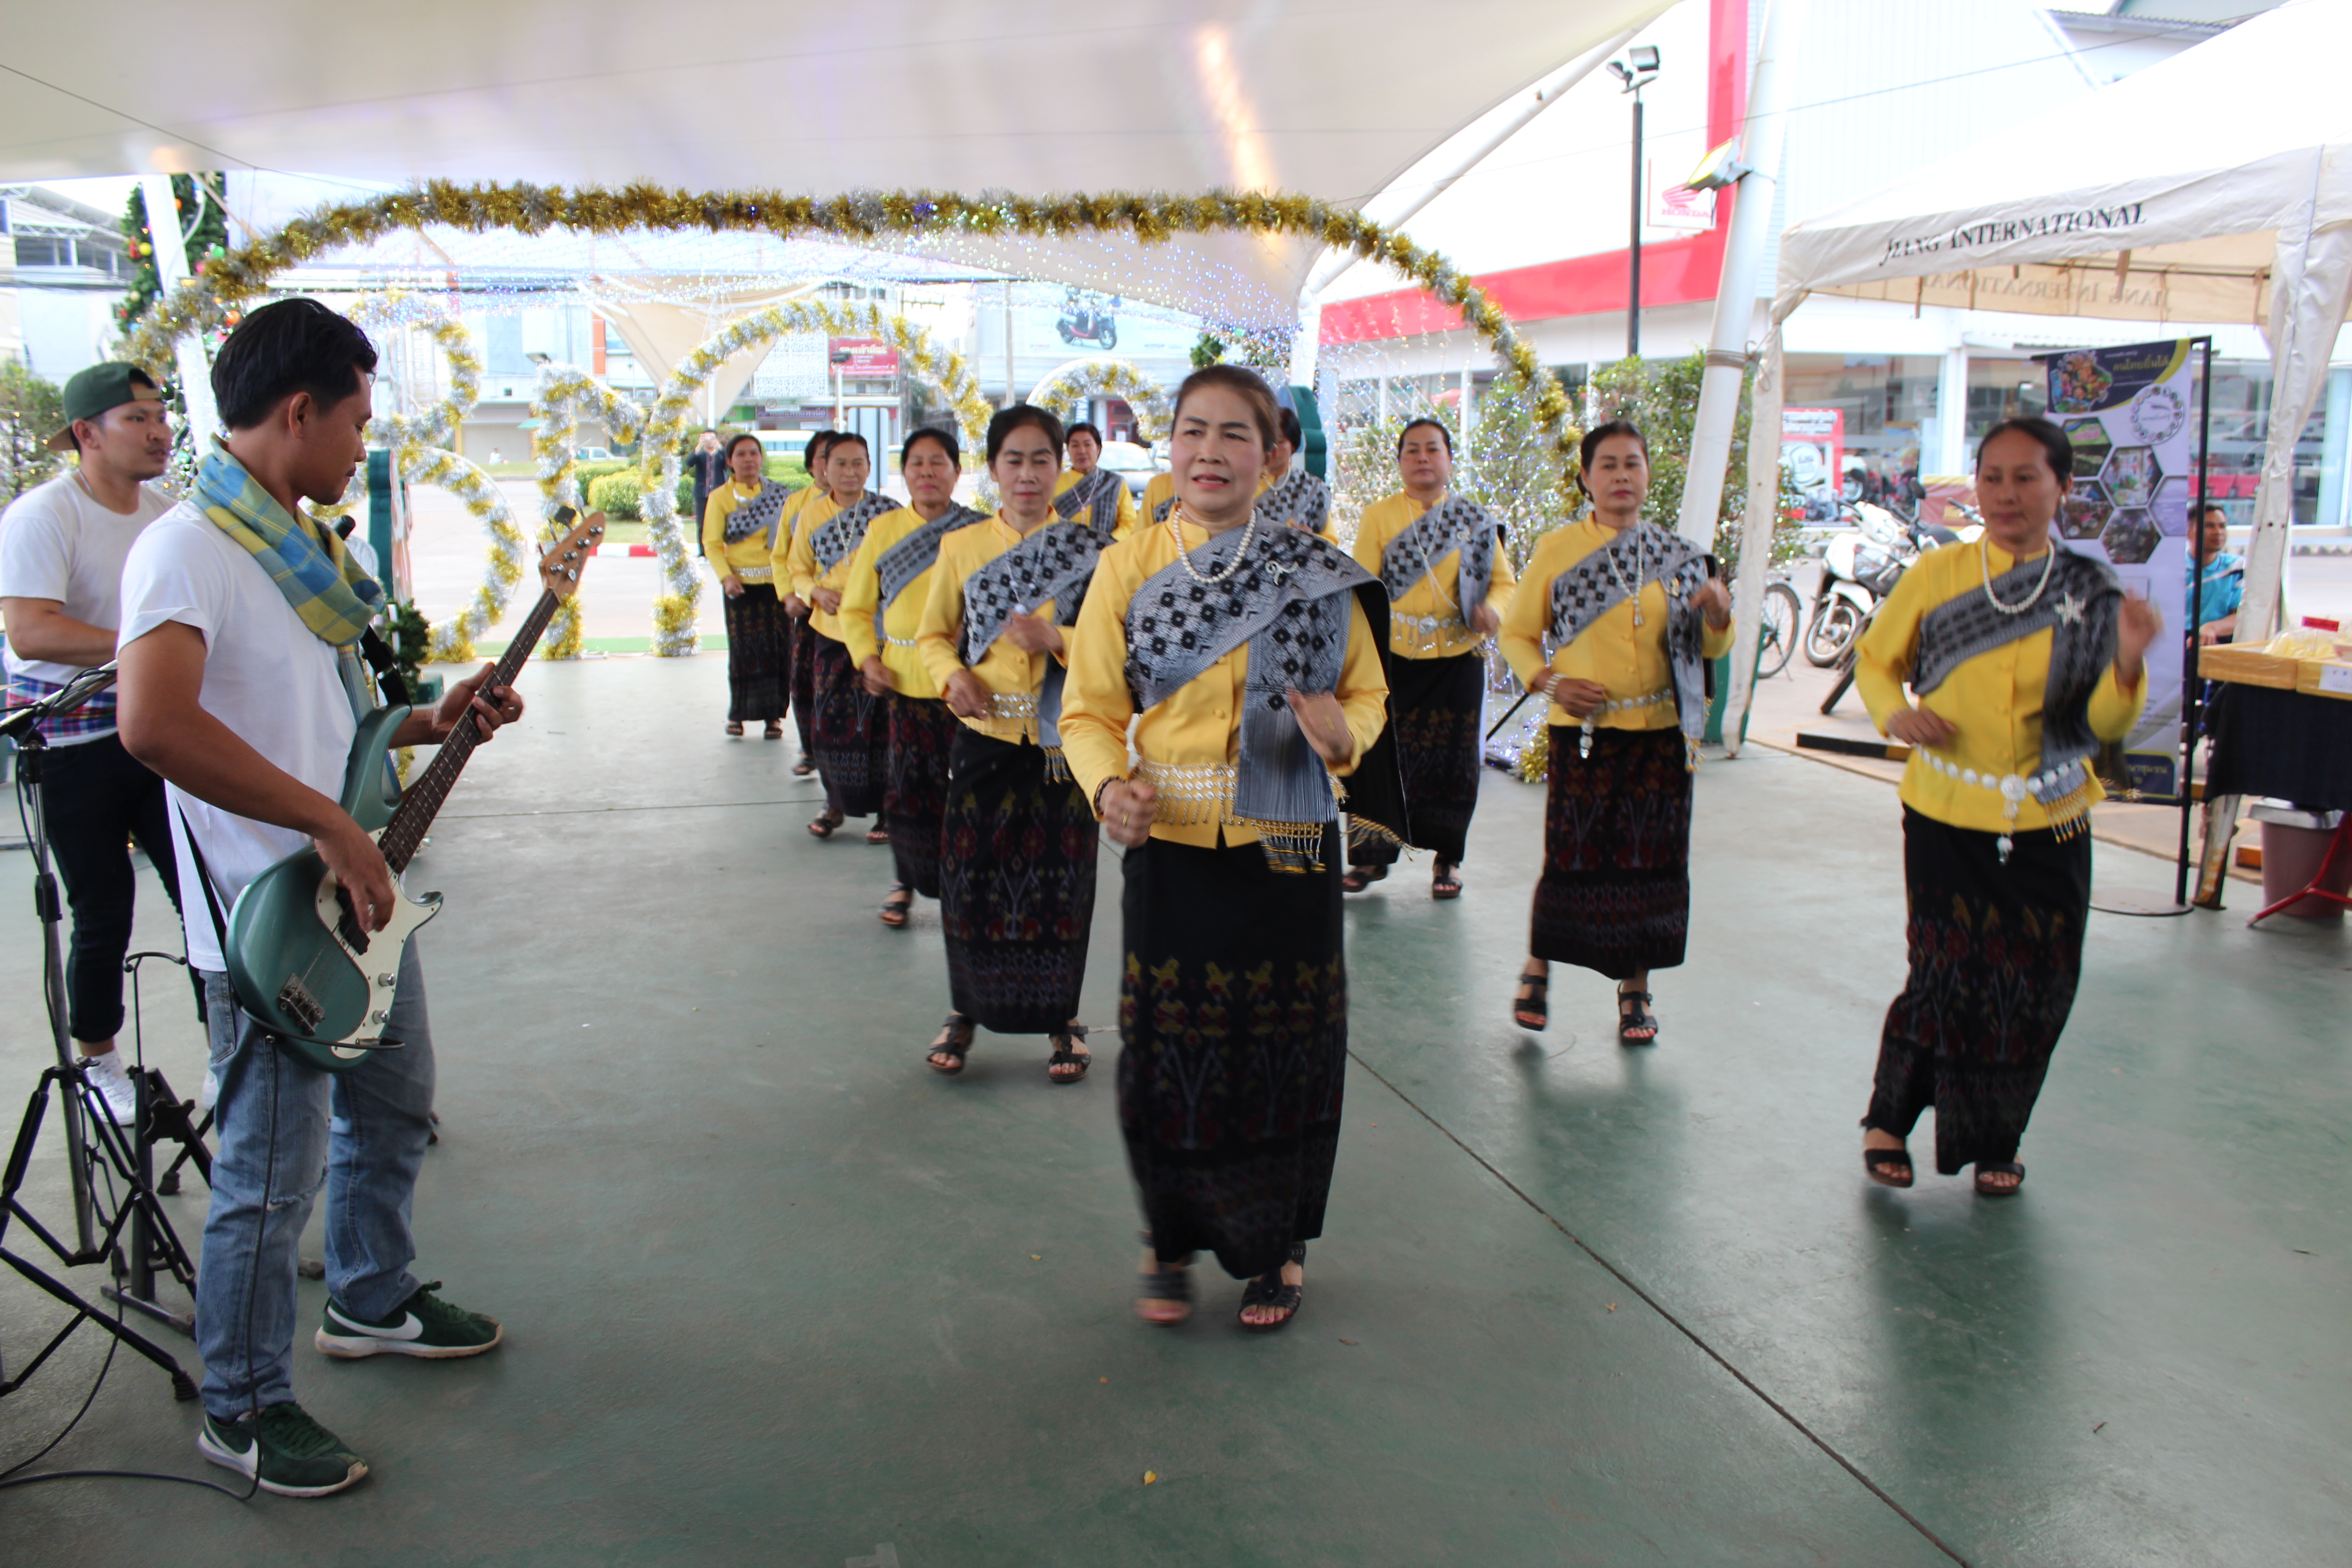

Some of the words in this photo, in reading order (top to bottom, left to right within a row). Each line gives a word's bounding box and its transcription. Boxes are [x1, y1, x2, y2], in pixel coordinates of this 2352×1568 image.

[1661, 207, 1711, 218] HONDA
[1879, 234, 1940, 266] JIANG
[1950, 203, 2146, 249] INTERNATIONAL
